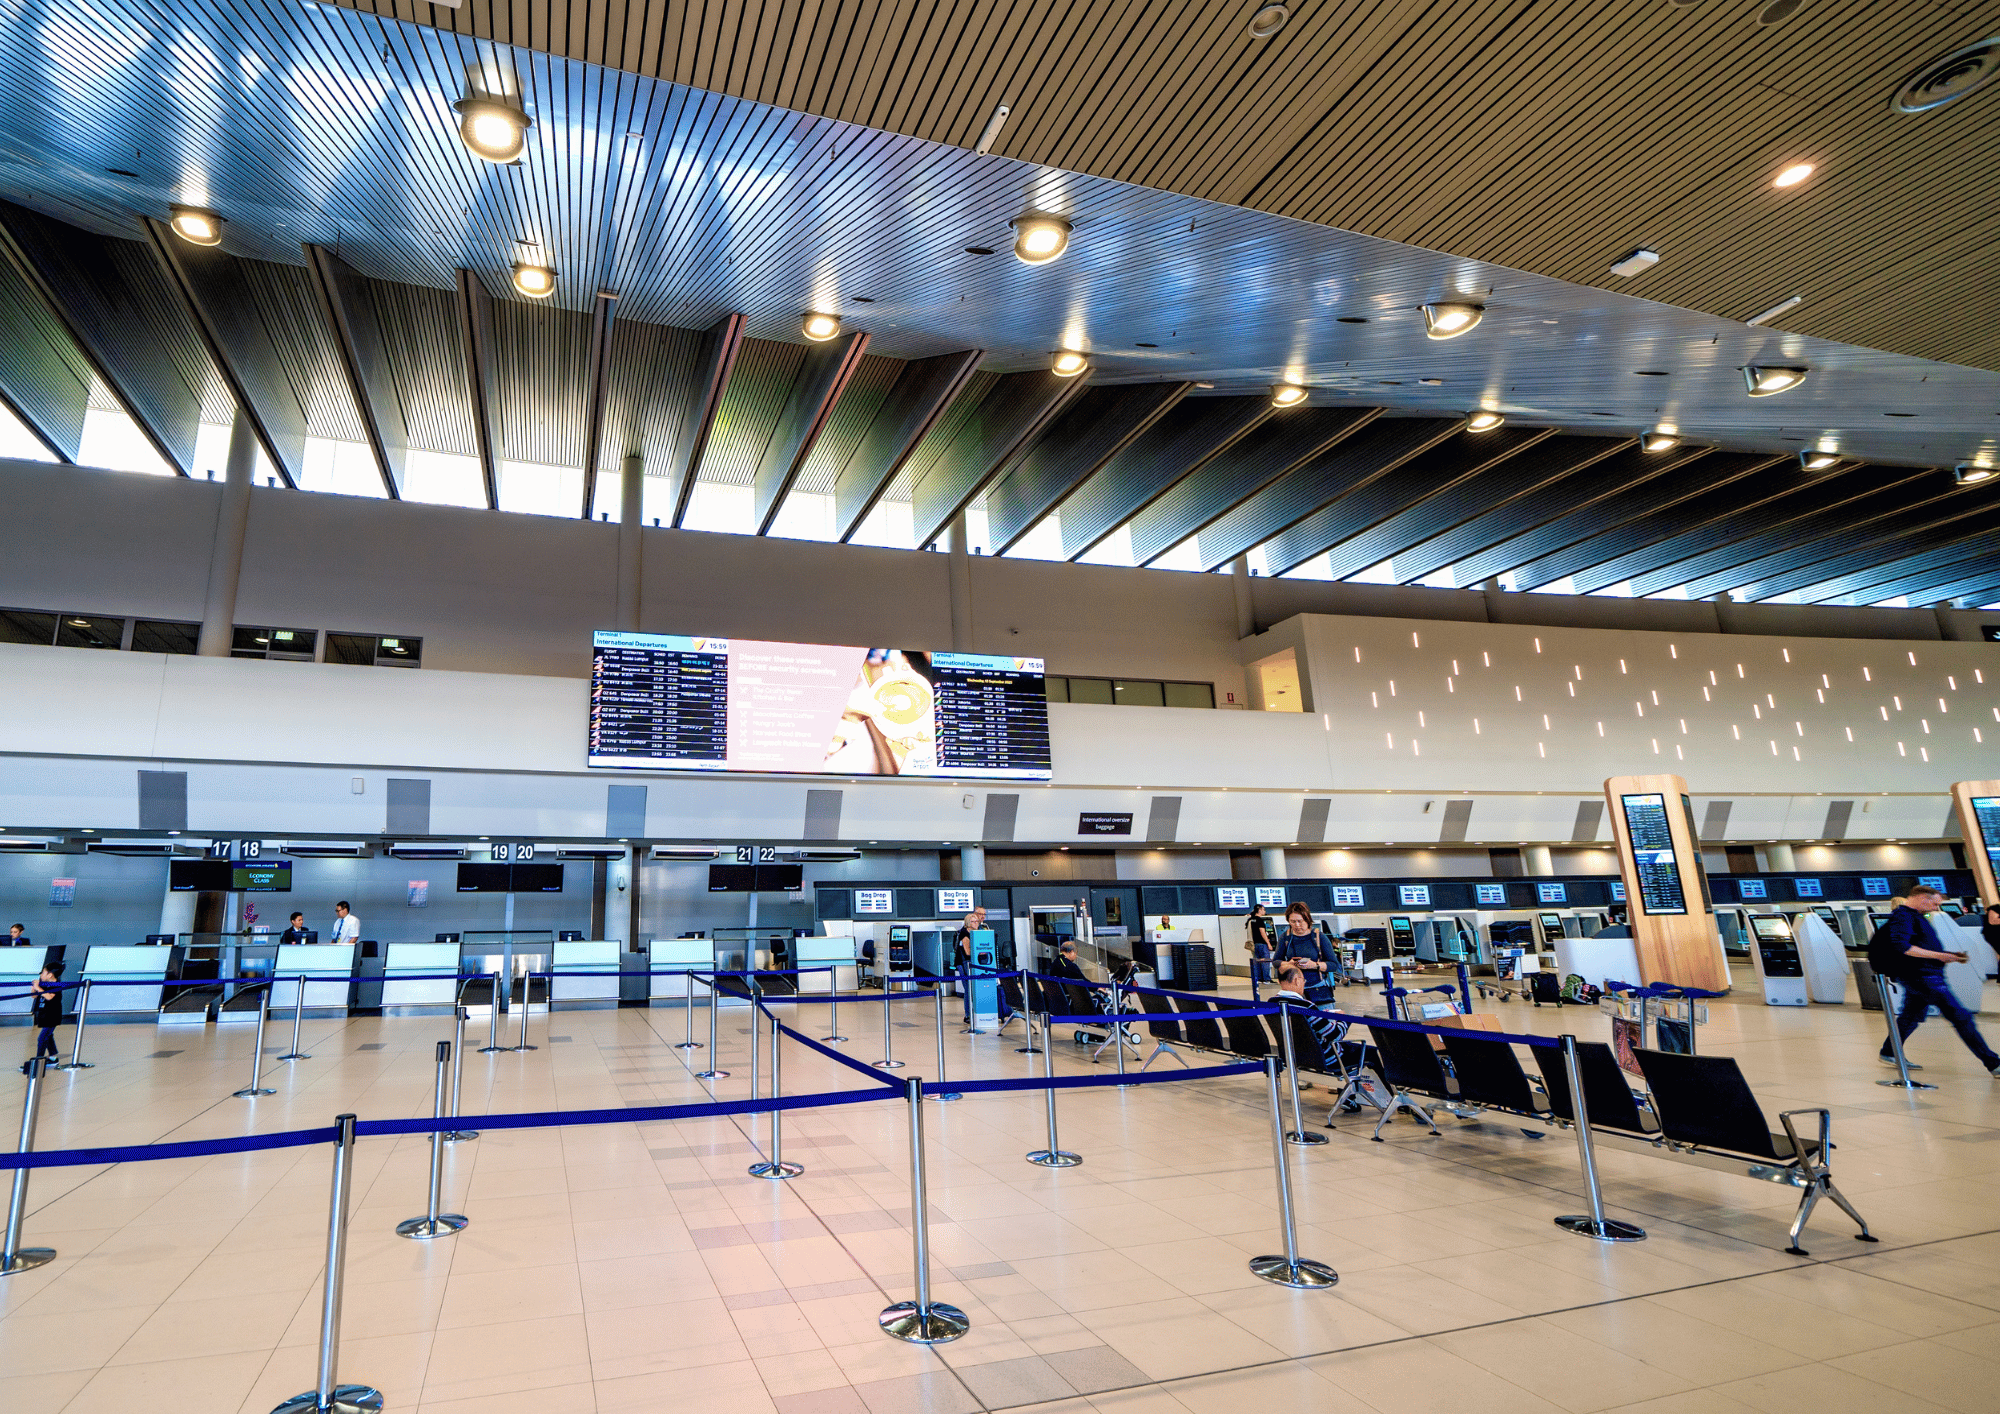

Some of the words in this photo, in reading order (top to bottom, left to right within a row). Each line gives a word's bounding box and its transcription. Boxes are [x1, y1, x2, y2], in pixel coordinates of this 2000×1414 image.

[635, 641, 667, 649] Departures
[738, 653, 771, 662] Discover
[738, 663, 767, 671] BEFORE
[768, 665, 798, 674] security
[800, 667, 836, 676] screening
[213, 841, 231, 856] 17
[241, 841, 259, 856] 18
[492, 845, 508, 859] 19
[517, 845, 533, 859] 20
[738, 847, 752, 860] 21
[760, 848, 775, 861] 22
